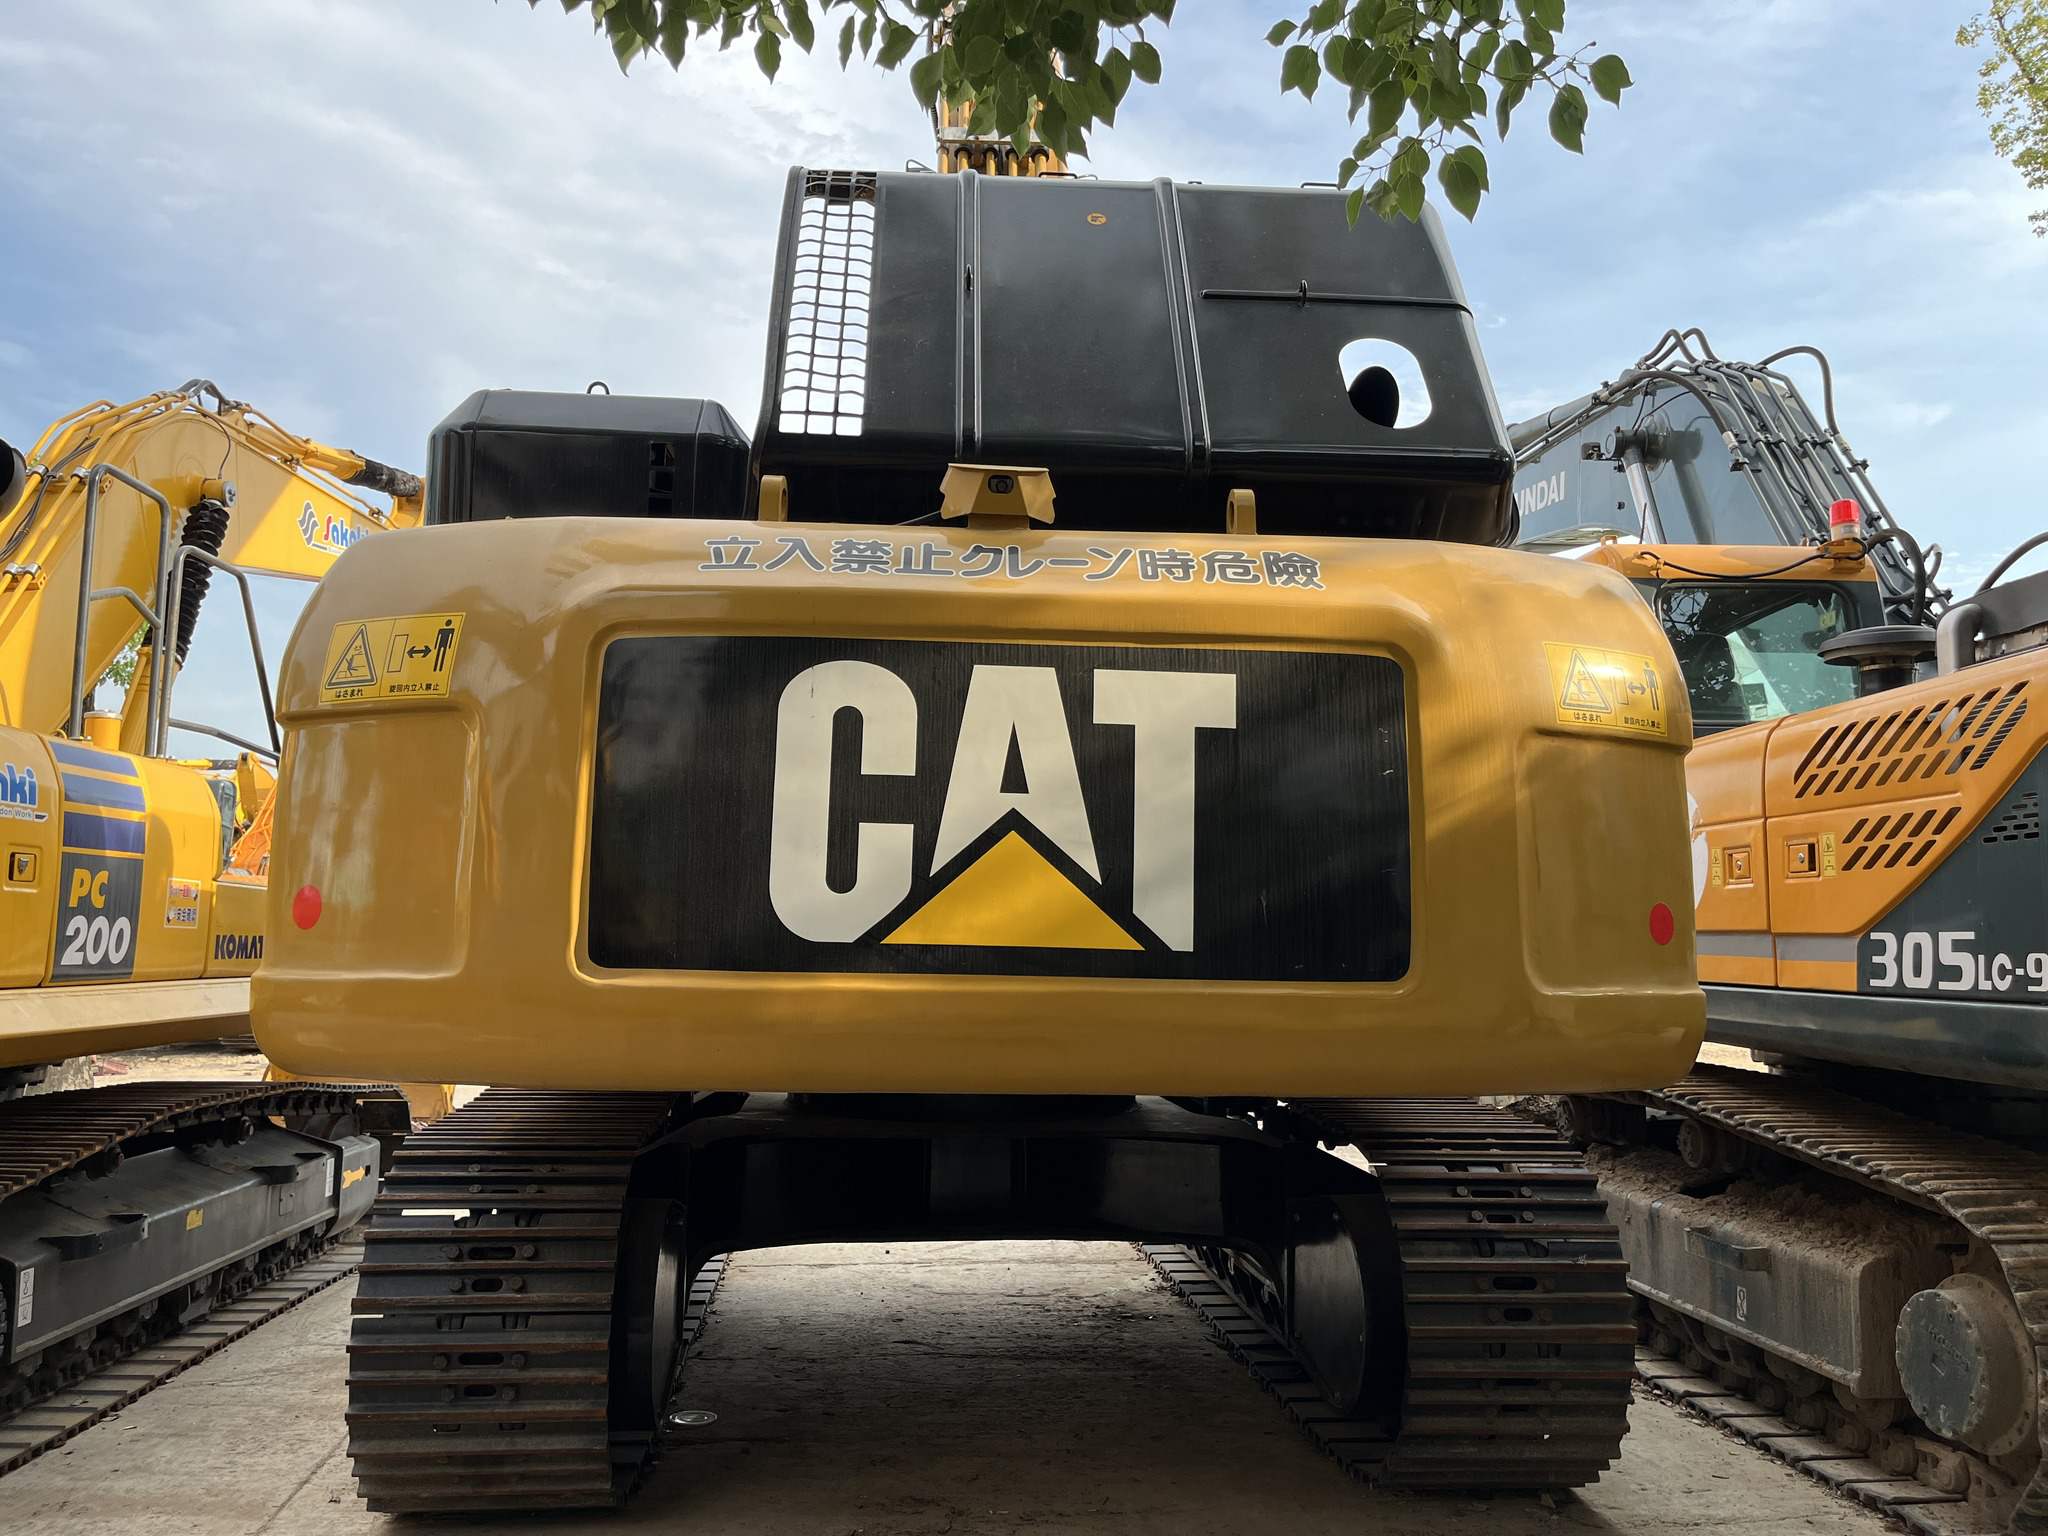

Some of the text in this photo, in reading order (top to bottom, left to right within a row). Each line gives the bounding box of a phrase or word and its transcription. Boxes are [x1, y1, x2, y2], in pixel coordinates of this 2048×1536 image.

[769, 660, 1237, 952] CAT
[68, 868, 110, 910] PC
[60, 915, 132, 966] 200
